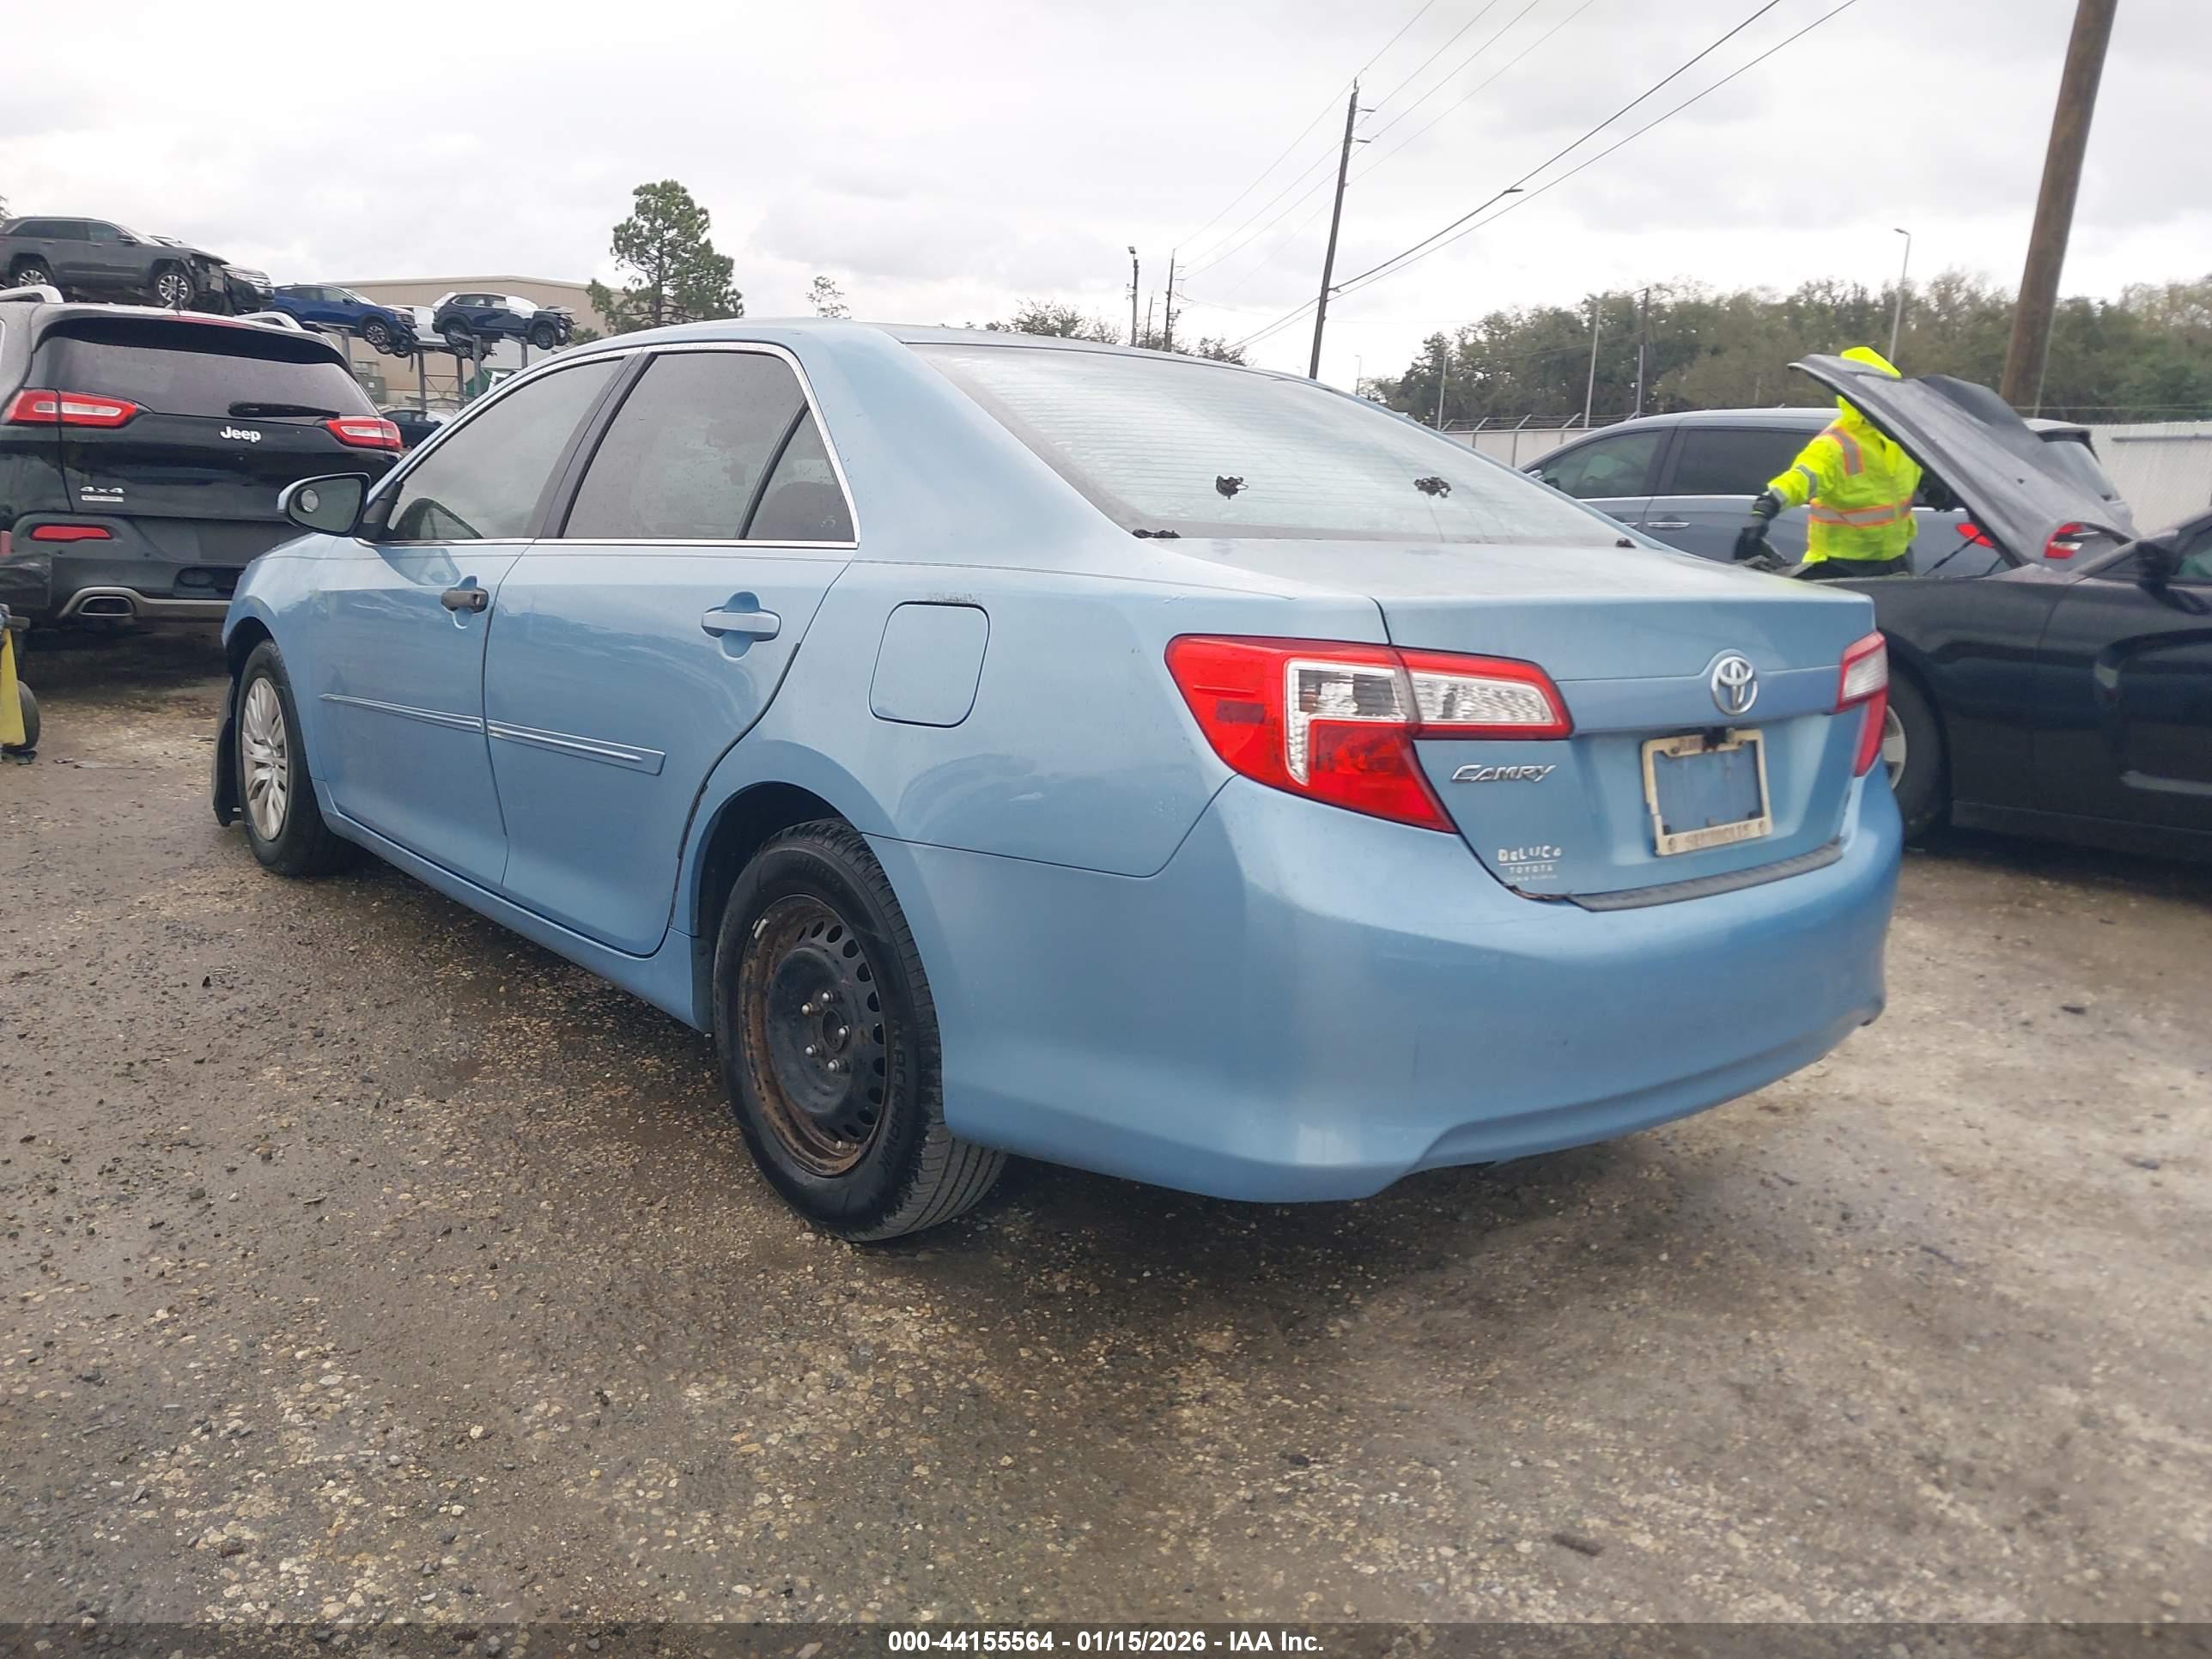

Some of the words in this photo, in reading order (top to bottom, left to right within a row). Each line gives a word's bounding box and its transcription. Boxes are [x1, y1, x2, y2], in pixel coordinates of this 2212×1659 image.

[220, 426, 261, 443] Jeep
[1451, 764, 1557, 782] CAMRY
[1509, 865, 1553, 874] TOYOTA
